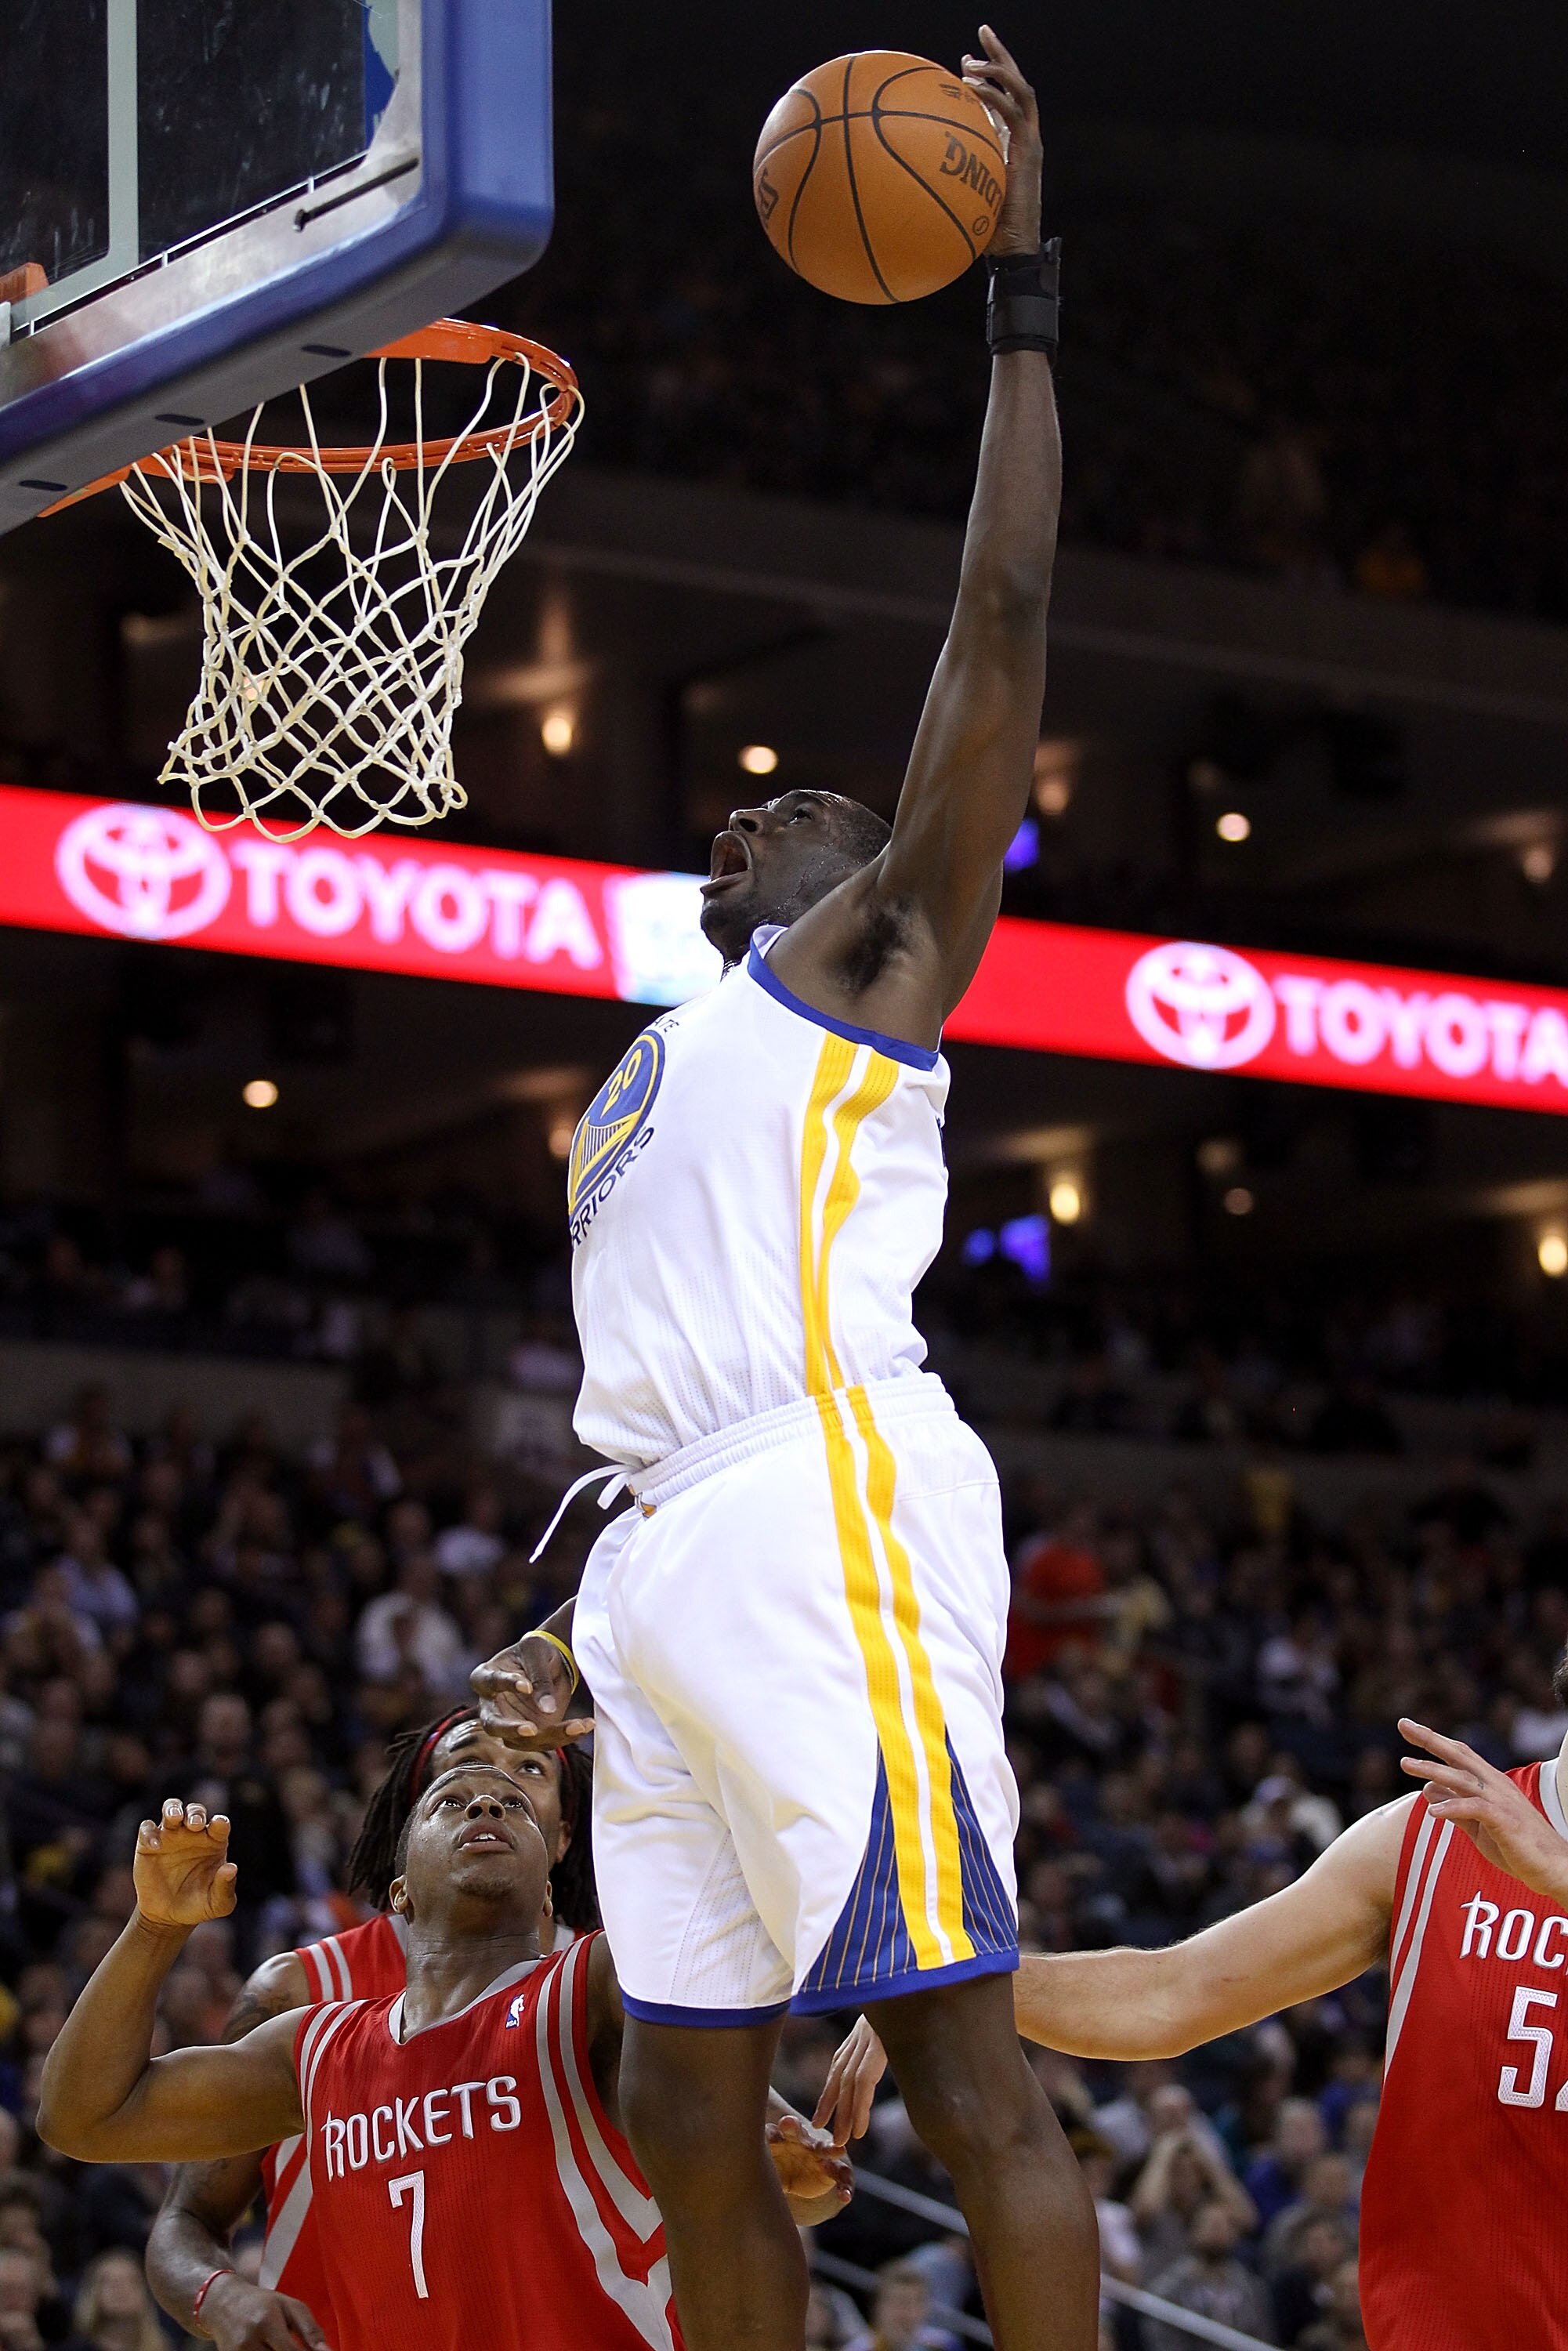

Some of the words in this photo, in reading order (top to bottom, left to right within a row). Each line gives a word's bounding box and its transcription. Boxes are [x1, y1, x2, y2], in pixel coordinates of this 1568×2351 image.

[233, 839, 603, 970] TOYOTA
[654, 1016, 680, 1033] ATE
[1272, 972, 1568, 1089] TOYOTA
[600, 1049, 643, 1120] 20
[573, 1126, 655, 1246] RRIORS
[1459, 1890, 1568, 1976] ROC
[320, 2075, 522, 2183] ROCKETS
[388, 2169, 429, 2299] 7
